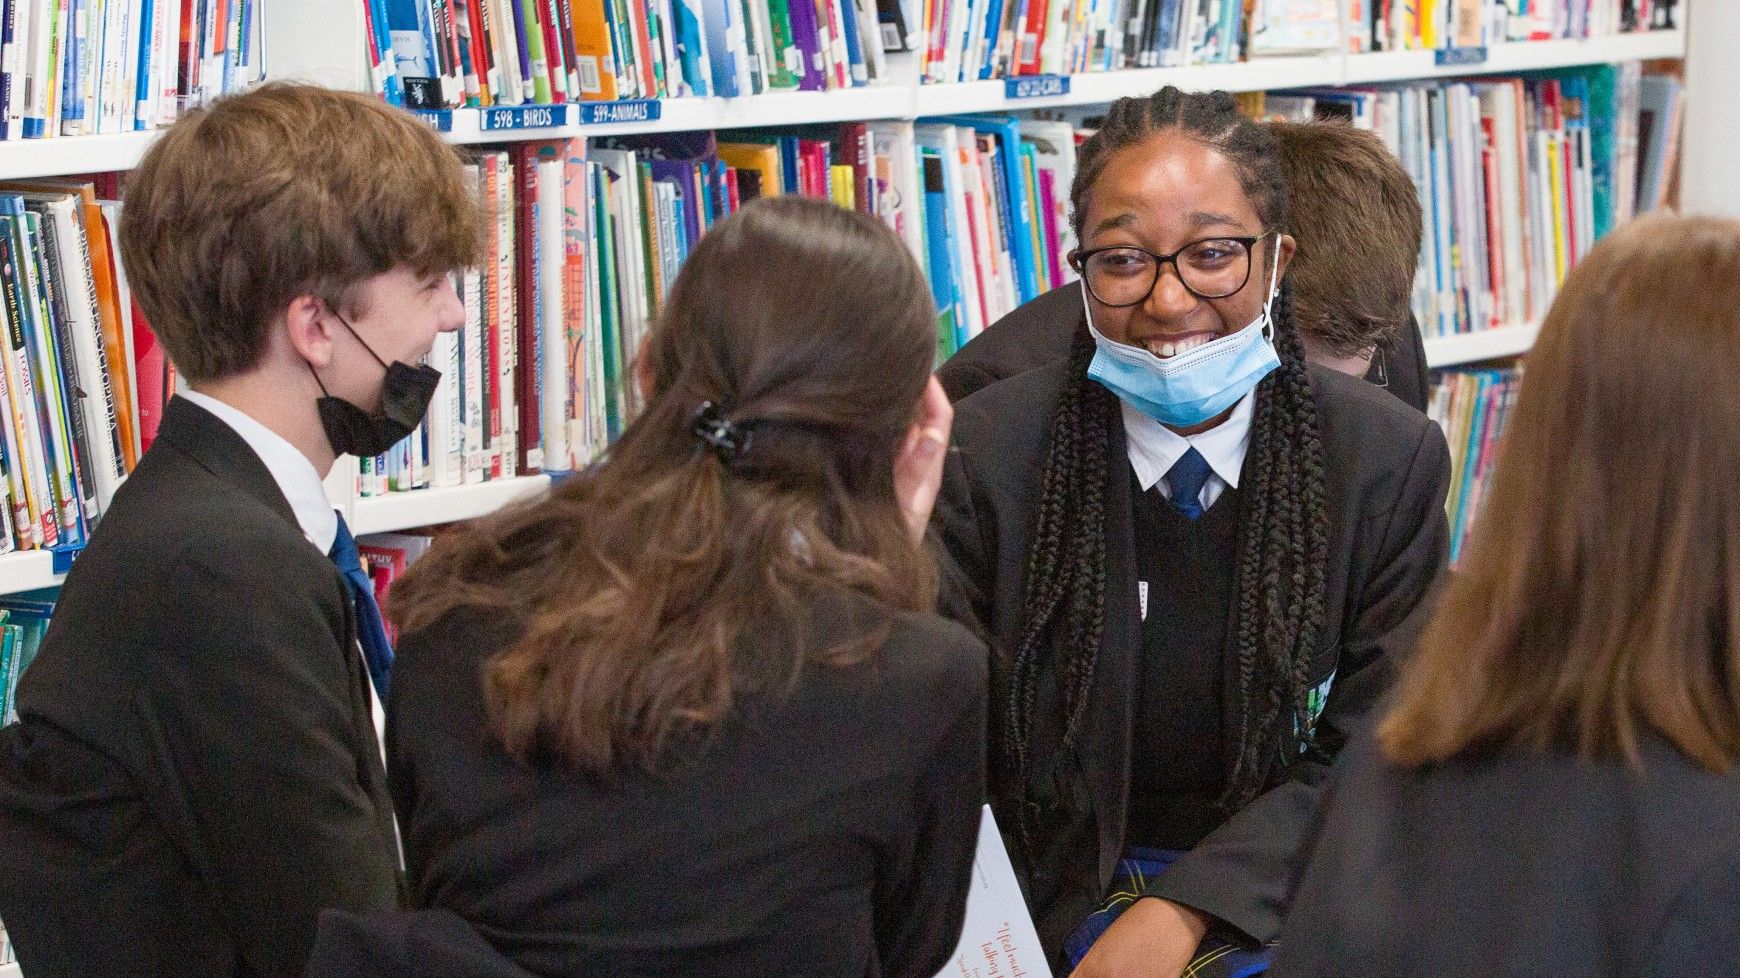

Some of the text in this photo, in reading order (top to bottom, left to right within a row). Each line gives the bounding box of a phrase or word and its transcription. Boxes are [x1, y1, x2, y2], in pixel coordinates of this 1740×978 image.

[493, 112, 513, 128] 598
[524, 108, 552, 128] BIRDS
[7, 282, 17, 308] Earth
[12, 311, 22, 343] Science
[29, 269, 37, 298] Water
[487, 257, 498, 326] INVENTIONS
[80, 228, 118, 431] DINOSAUR ENCYCLOPEDIA
[501, 266, 511, 366] INVENTIONS
[20, 354, 32, 395] FOSSILS
